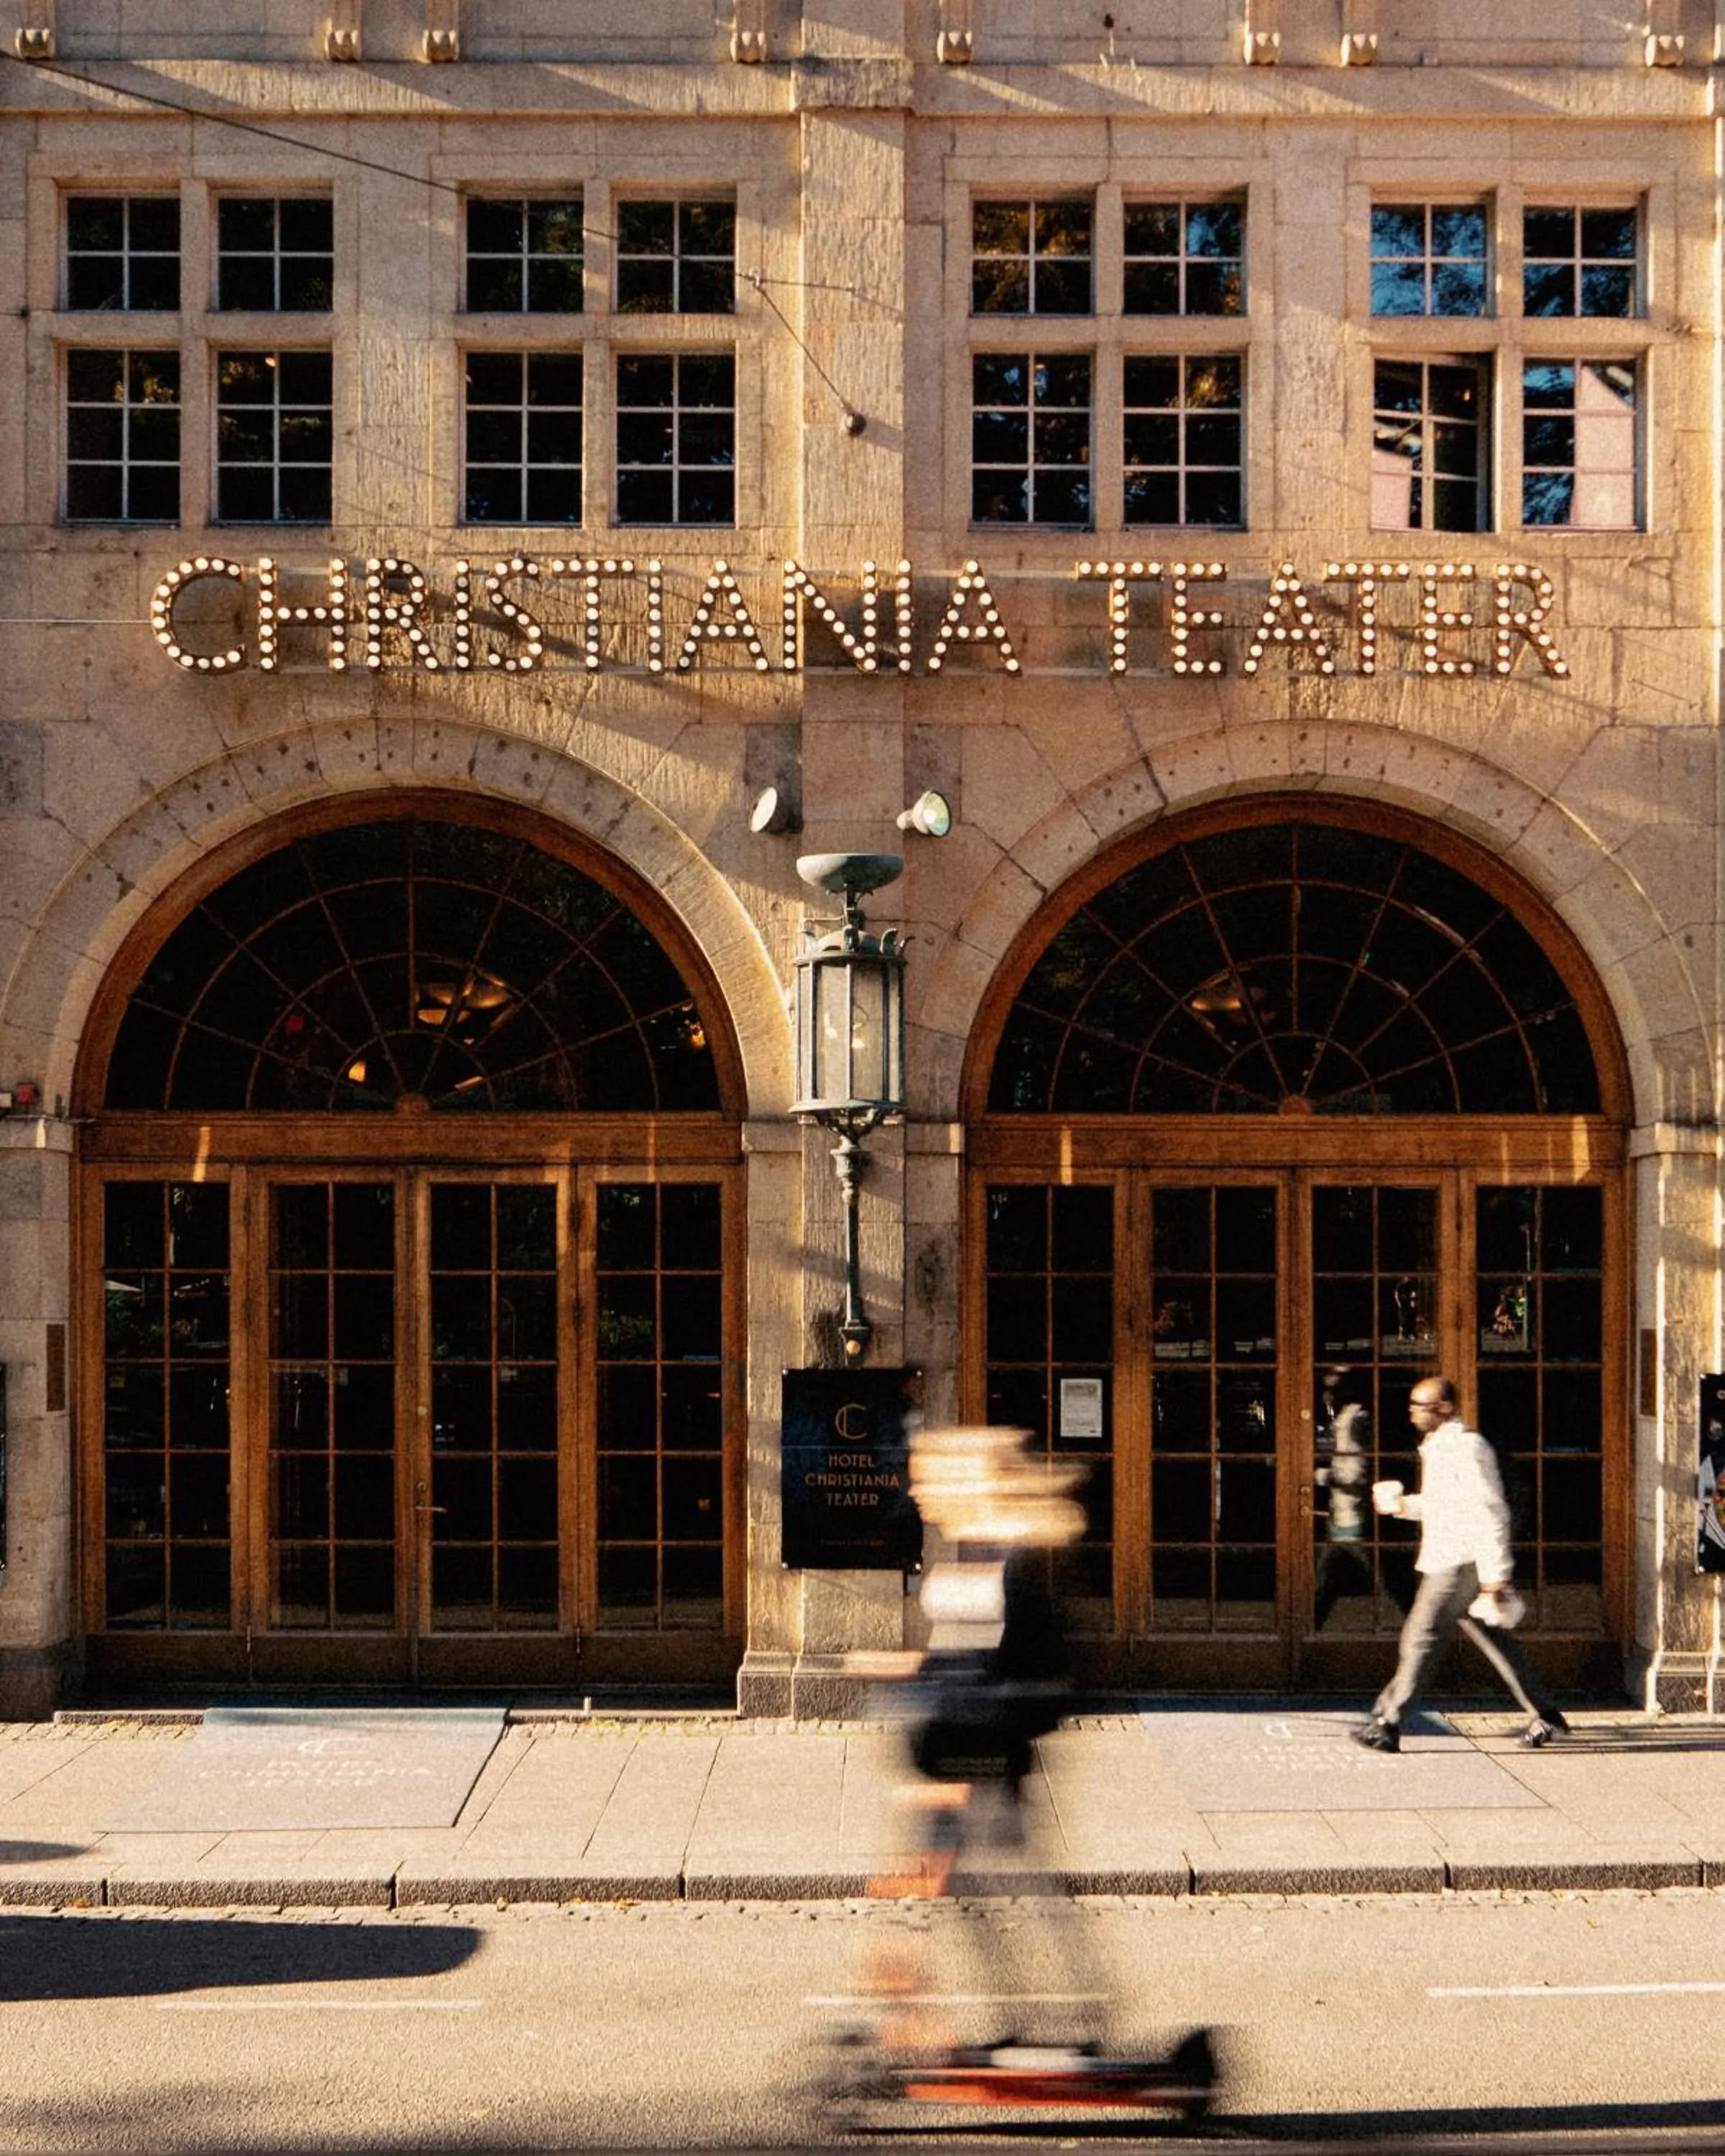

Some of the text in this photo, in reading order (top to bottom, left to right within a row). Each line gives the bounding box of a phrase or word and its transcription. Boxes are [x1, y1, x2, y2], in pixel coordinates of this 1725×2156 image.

[151, 556, 1570, 678] CHRISTIANIA TEATER
[828, 1453, 875, 1468] HOTEL
[804, 1473, 900, 1488] CHRISTIANIA
[827, 1492, 880, 1506] TEATER
